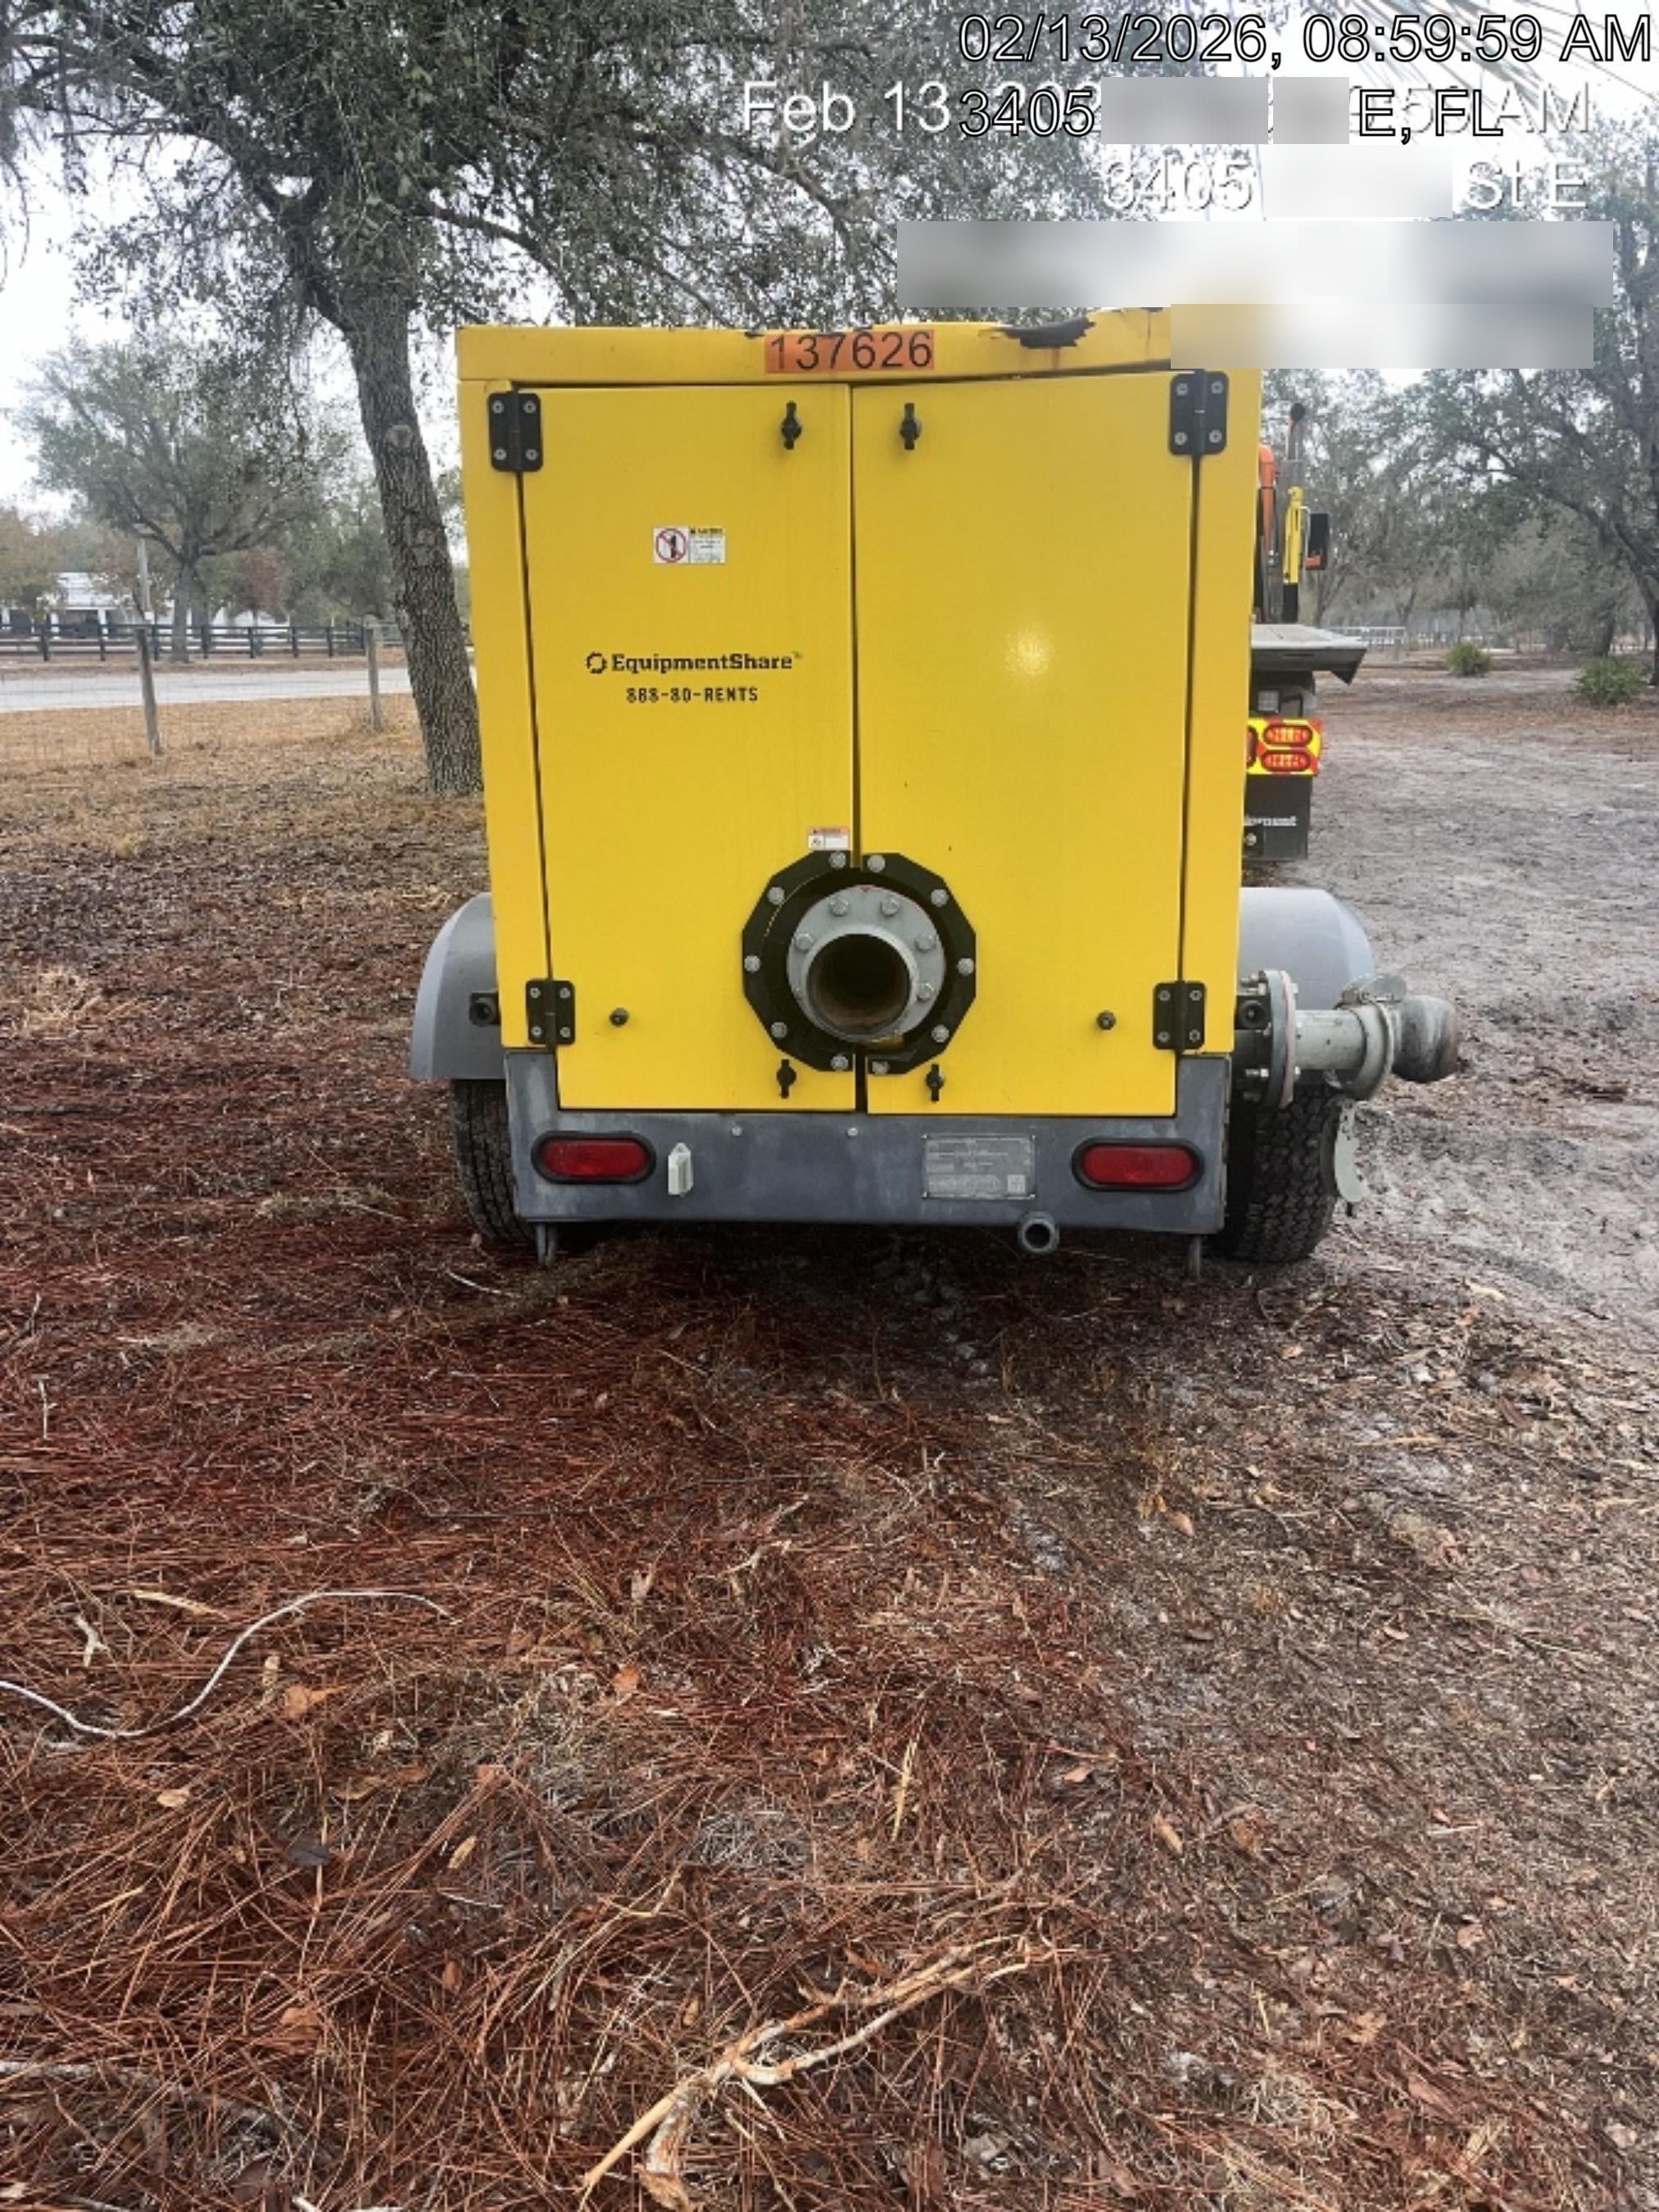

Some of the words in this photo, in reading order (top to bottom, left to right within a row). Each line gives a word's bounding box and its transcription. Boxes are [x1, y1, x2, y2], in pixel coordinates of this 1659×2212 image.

[771, 331, 933, 370] 137626
[611, 653, 793, 673] EquipmentShare
[626, 687, 759, 704] 888-80-RENTS
